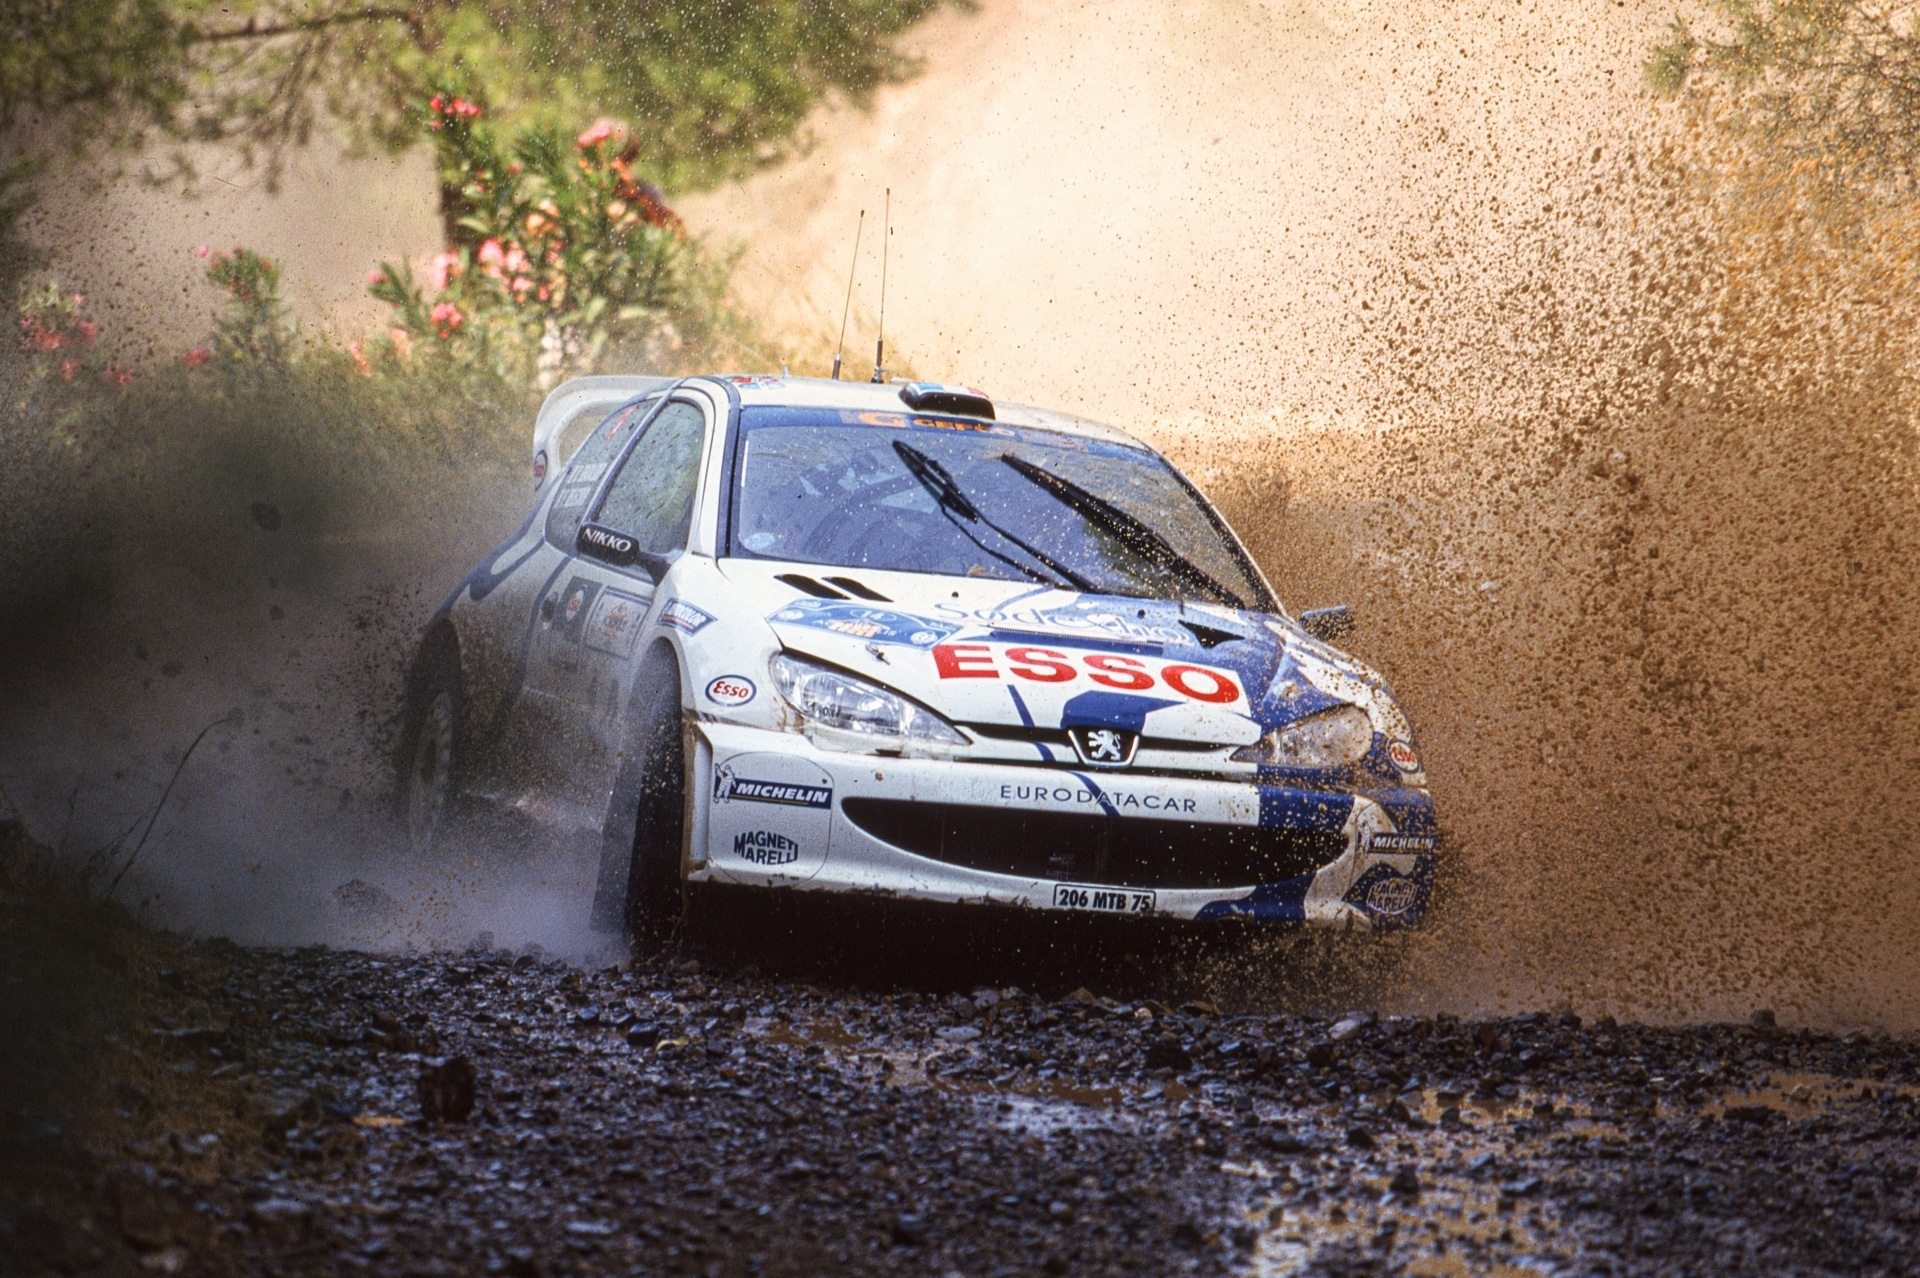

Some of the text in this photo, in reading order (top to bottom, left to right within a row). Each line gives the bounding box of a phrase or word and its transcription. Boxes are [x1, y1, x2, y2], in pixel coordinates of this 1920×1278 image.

[582, 528, 631, 552] NIKKO
[932, 644, 1240, 704] ESSO
[736, 782, 829, 804] MICHELIN
[1000, 785, 1197, 813] EURODATACAR
[734, 830, 798, 854] MAGNETI
[1374, 836, 1434, 849] MICHELIN
[1059, 889, 1152, 912] 206 MTB 75
